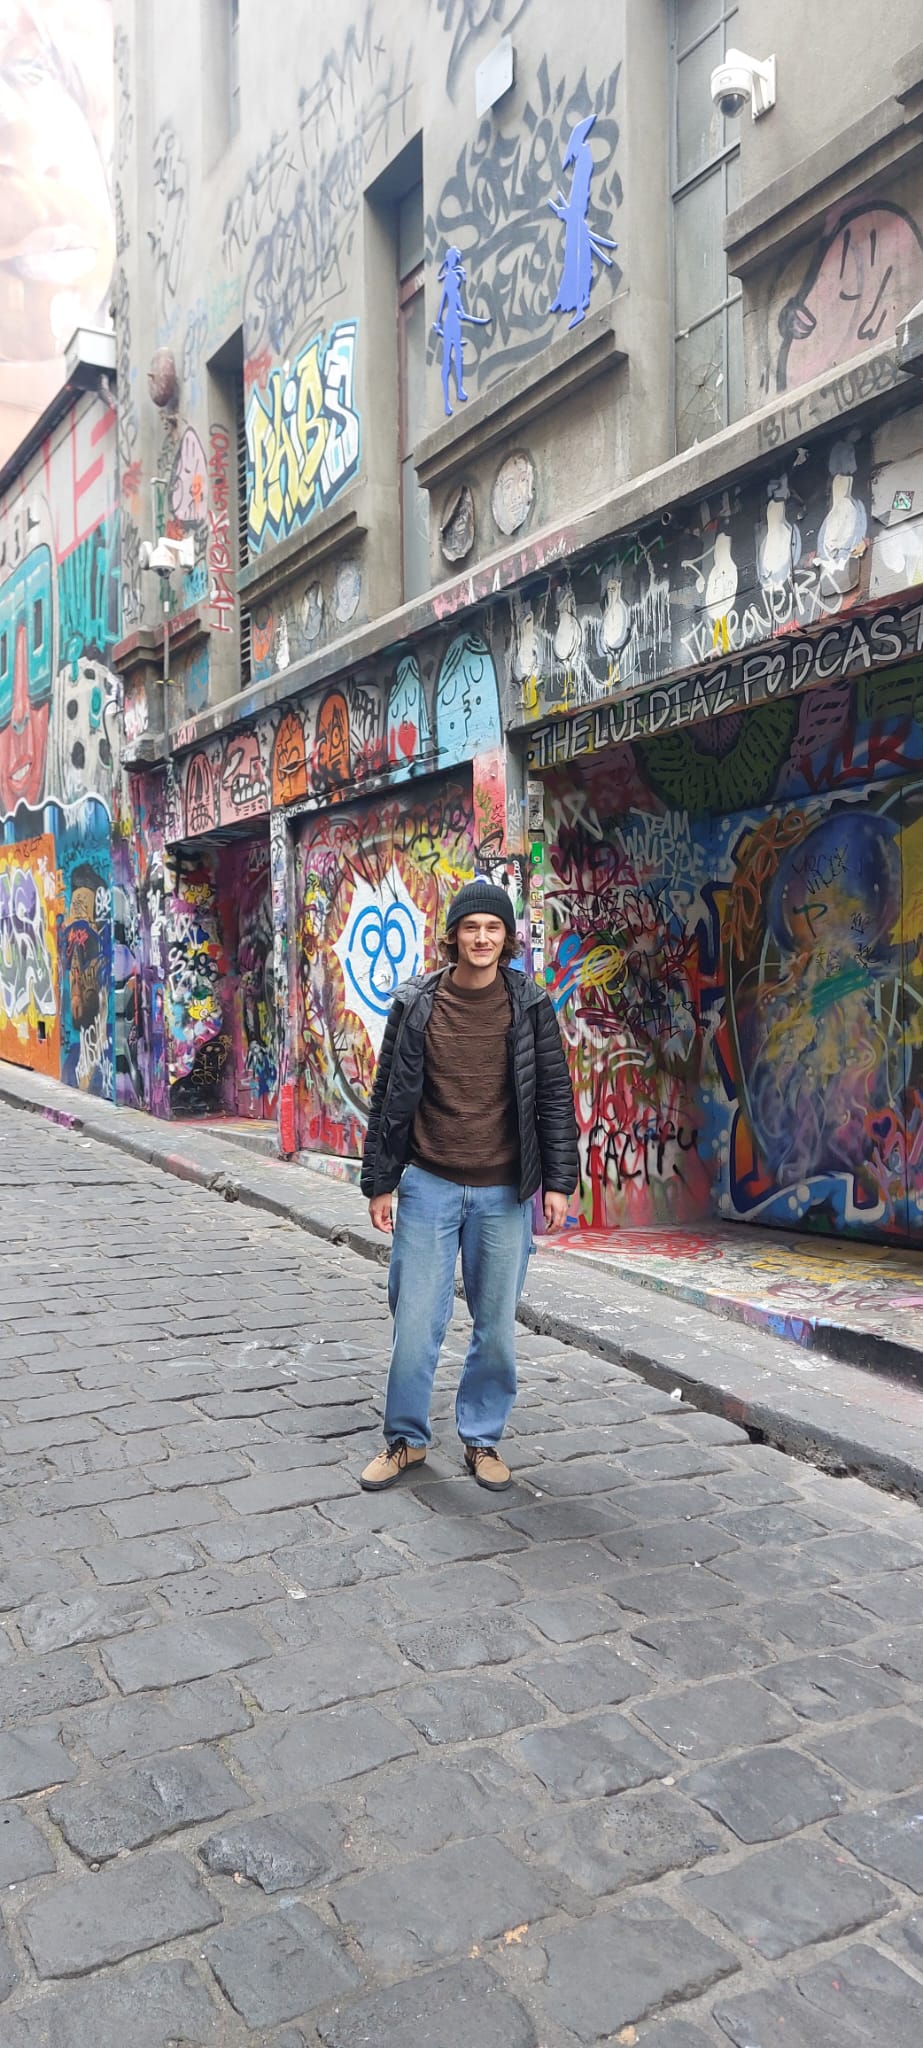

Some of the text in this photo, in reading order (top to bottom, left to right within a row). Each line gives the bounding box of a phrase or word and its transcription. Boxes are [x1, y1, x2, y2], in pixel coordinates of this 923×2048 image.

[531, 713, 591, 767] THE
[648, 671, 735, 734] DIAZ
[743, 604, 923, 704] PODCAST
